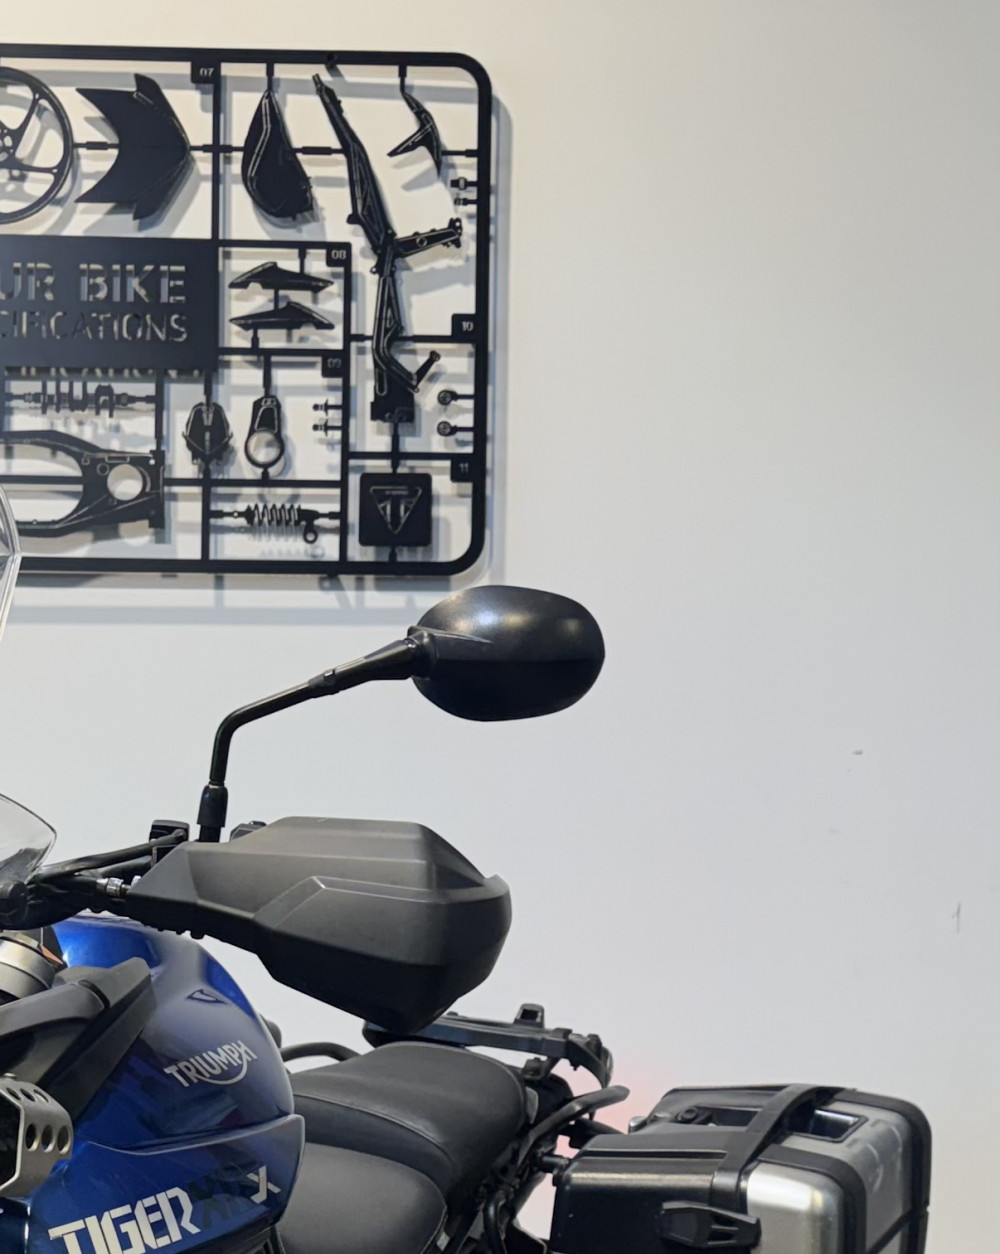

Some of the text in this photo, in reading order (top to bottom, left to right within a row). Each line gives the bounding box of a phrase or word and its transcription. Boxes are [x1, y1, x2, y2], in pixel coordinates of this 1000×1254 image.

[199, 67, 215, 77] 07
[331, 249, 347, 260] 08
[79, 262, 187, 304] BIKE
[461, 320, 474, 332] 10
[459, 462, 470, 474] 11
[163, 1040, 259, 1088] TRIUMPH
